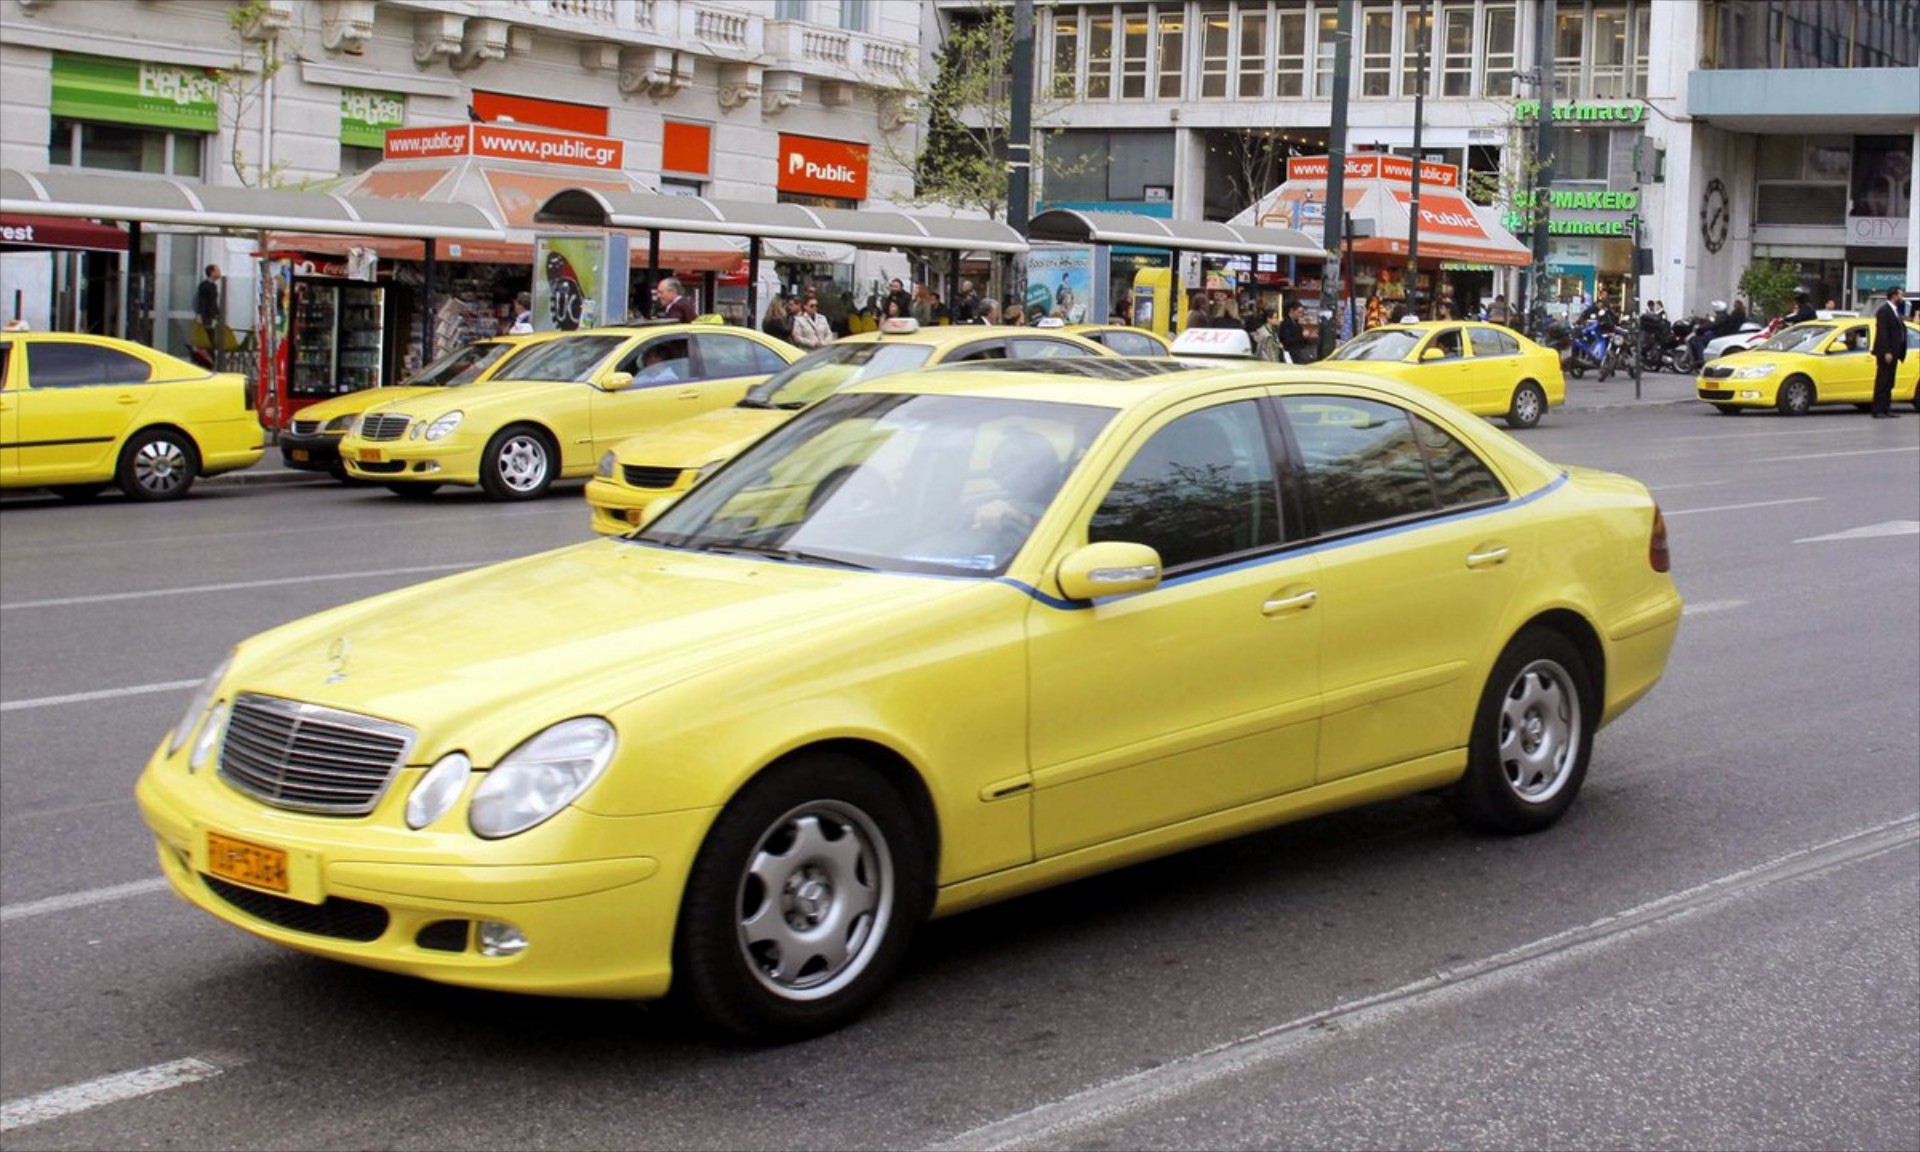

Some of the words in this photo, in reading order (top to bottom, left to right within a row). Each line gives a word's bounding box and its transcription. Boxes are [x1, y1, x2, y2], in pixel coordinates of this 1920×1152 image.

[389, 132, 466, 154] www.public.gr
[481, 134, 615, 164] www.public.gr
[806, 162, 855, 183] Public
[1293, 160, 1373, 177] www.blic.gr
[1524, 217, 1622, 234] armacie
[1184, 330, 1233, 343] TAXI
